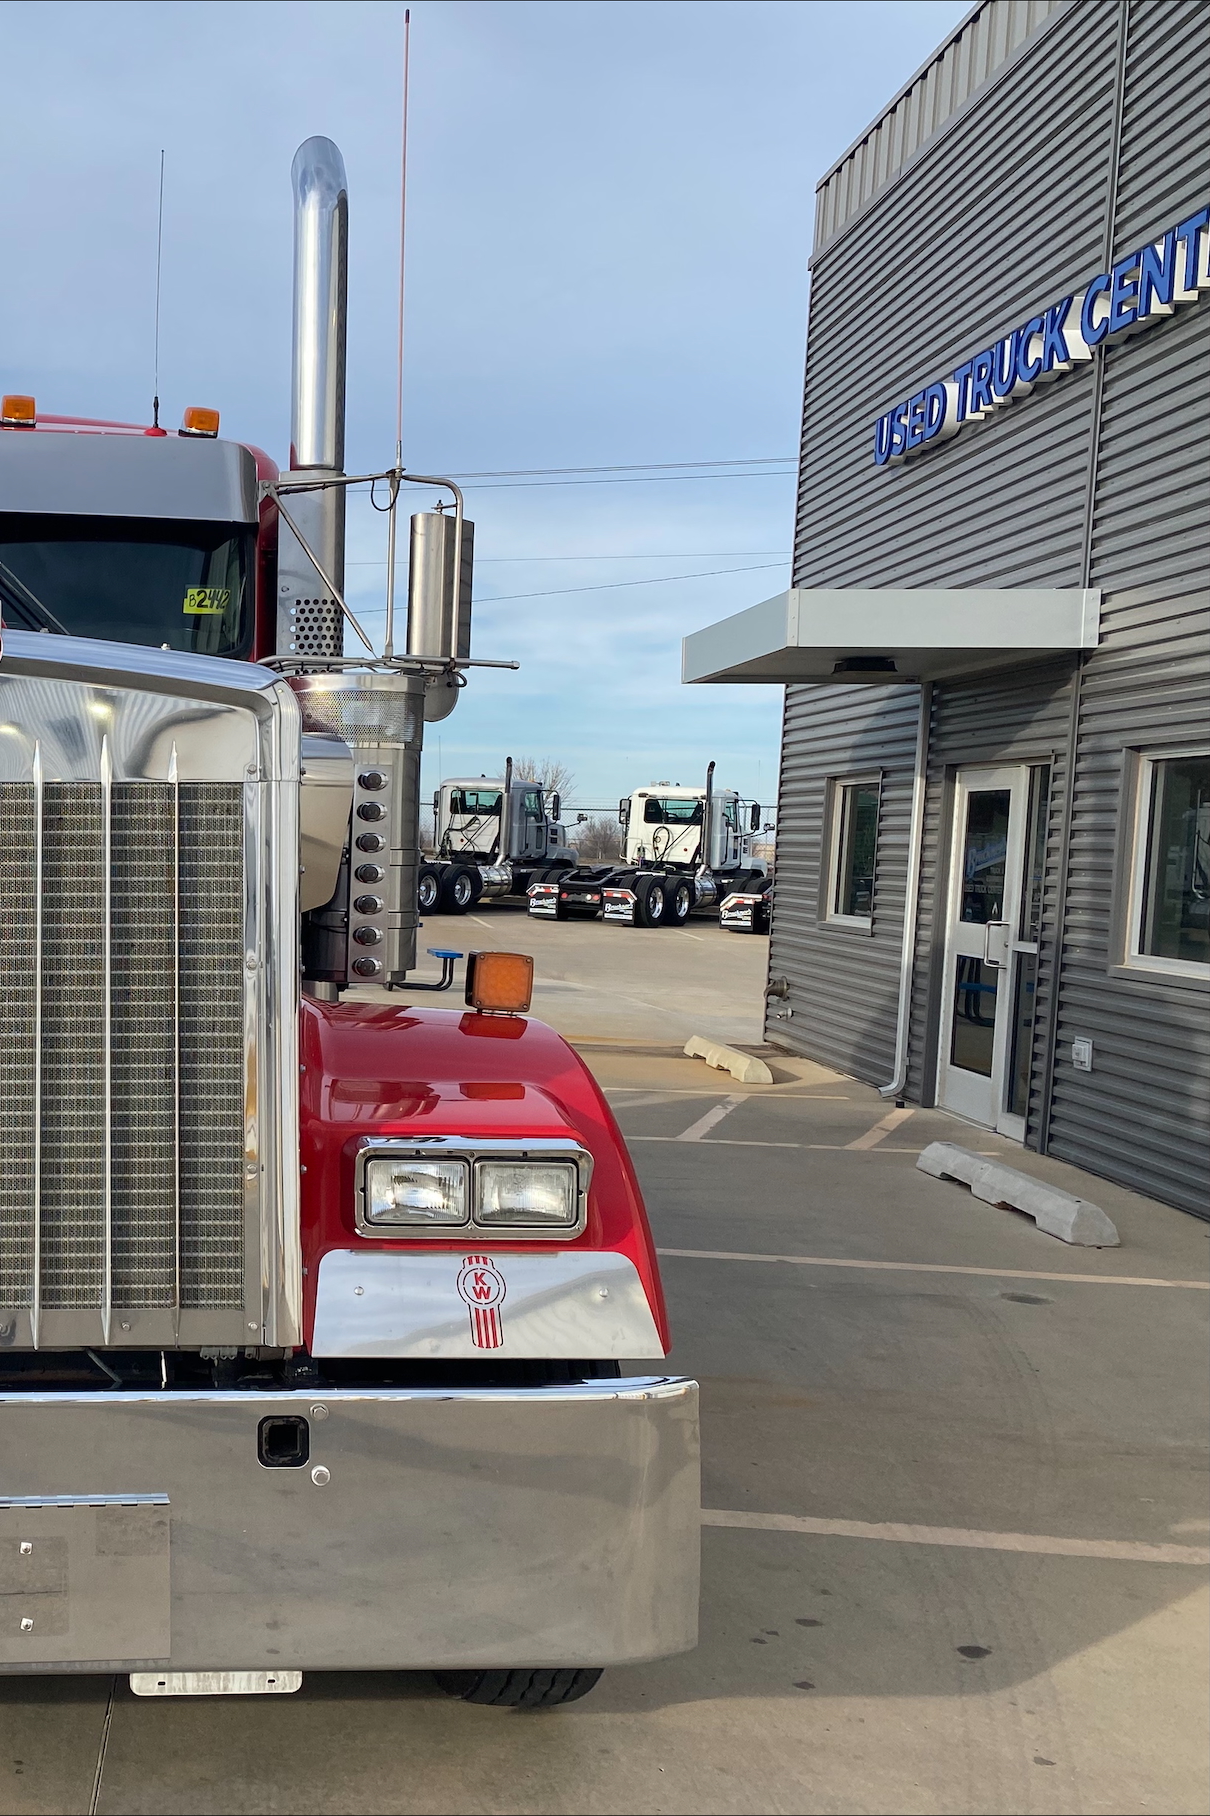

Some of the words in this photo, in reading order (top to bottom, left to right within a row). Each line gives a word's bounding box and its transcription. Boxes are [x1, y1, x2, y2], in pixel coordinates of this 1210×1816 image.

[874, 382, 947, 465] USED
[953, 296, 1075, 422] TRUCK
[1080, 207, 1210, 346] CENT
